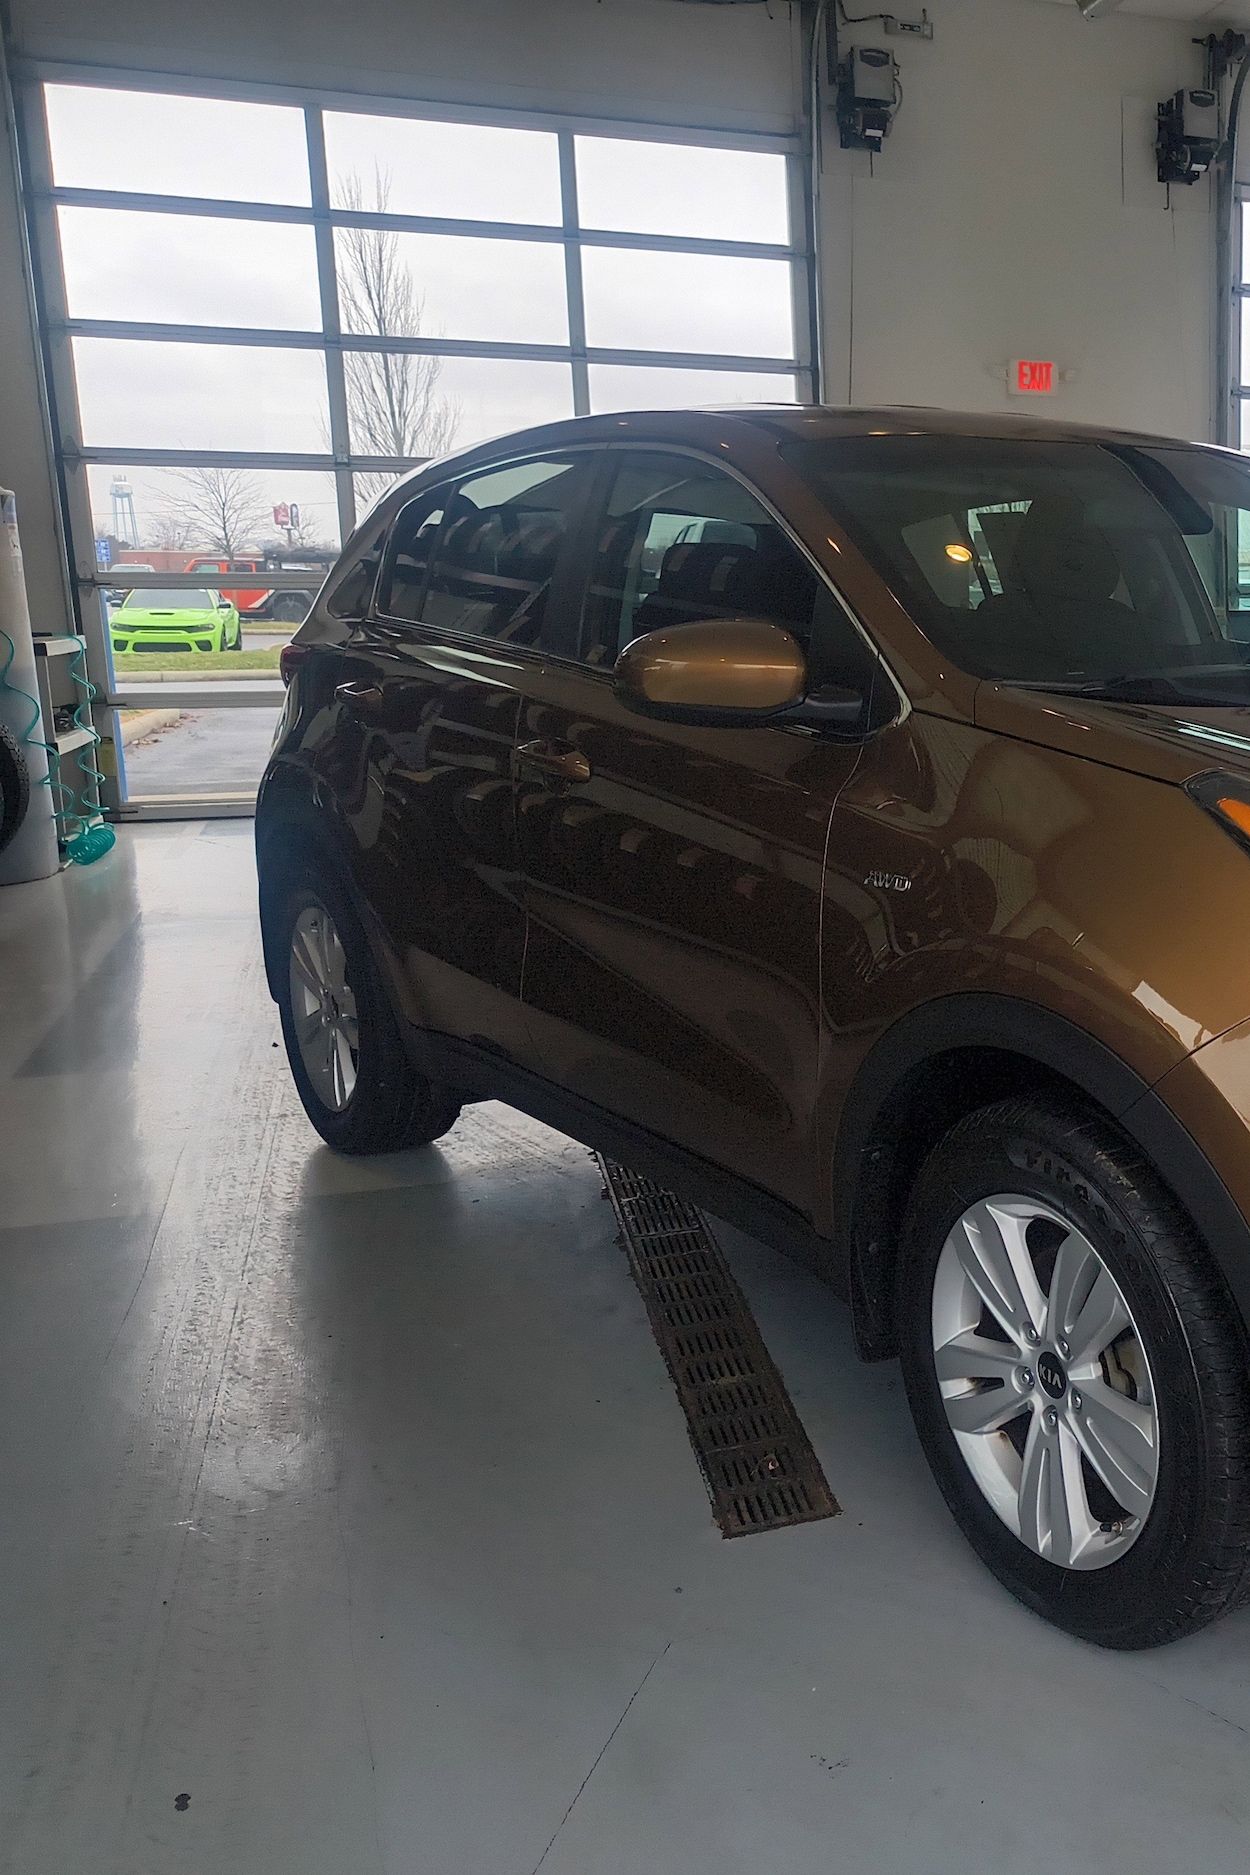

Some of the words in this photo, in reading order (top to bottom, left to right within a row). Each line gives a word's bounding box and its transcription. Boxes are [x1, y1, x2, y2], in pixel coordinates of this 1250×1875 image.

[1018, 361, 1053, 391] EXIT
[863, 870, 911, 892] AWD
[1039, 1363, 1063, 1389] KIA
